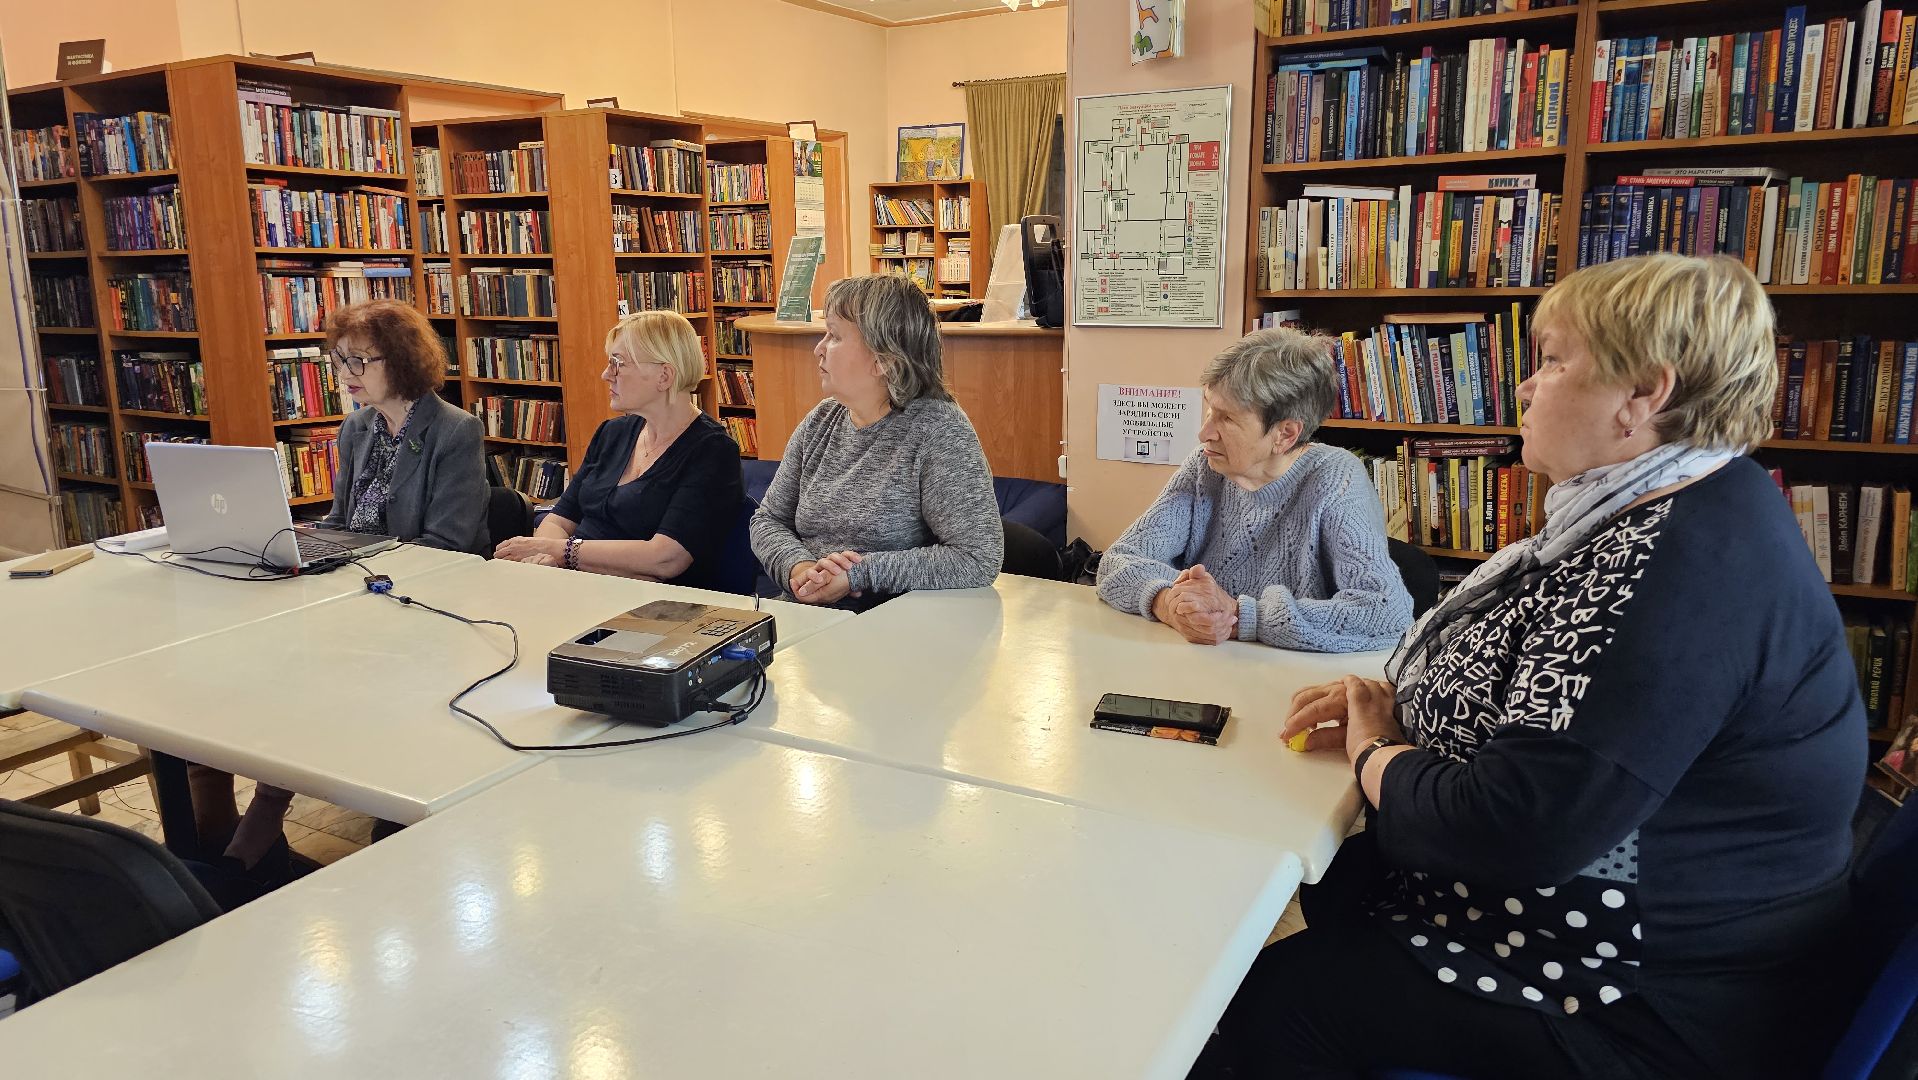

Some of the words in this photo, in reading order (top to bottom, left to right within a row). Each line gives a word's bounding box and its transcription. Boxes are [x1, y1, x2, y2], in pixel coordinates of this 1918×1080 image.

[1899, 24, 1912, 81] ИНВЕСТИЦИИ
[1678, 93, 1689, 134] ЛОНДОН
[1645, 196, 1655, 237] ЭКОНОМИКА
[1748, 192, 1761, 251] ДЕЛОПРОИЗВОДСТВО
[1814, 209, 1825, 252] ФИНАНСЫ
[1432, 352, 1440, 377] РАБОТЫ
[1904, 347, 1918, 379] УЧИТЕЛЯ
[1119, 387, 1181, 398] ВНИМАНИЕ!
[1878, 351, 1892, 413] КУЛЬТУРОЛОГИЯ
[1902, 382, 1913, 400] РЕЧИ
[1118, 409, 1156, 418] ЗАРЯДИТЬ
[1151, 402, 1187, 410] МОЖЕТЕ
[1436, 380, 1445, 420] ОТДЕЛОЧНЫЕ
[1122, 428, 1173, 437] УСТРОЙСТВА
[1123, 420, 1173, 428] МОБИЛЬНЫЕ
[1898, 403, 1910, 439] КУЛЬТУРА
[1500, 474, 1508, 501] ПАСЕКА
[211, 493, 227, 514] hp
[1499, 505, 1508, 520] МЁД
[1838, 492, 1848, 528] КАРНЕГИ
